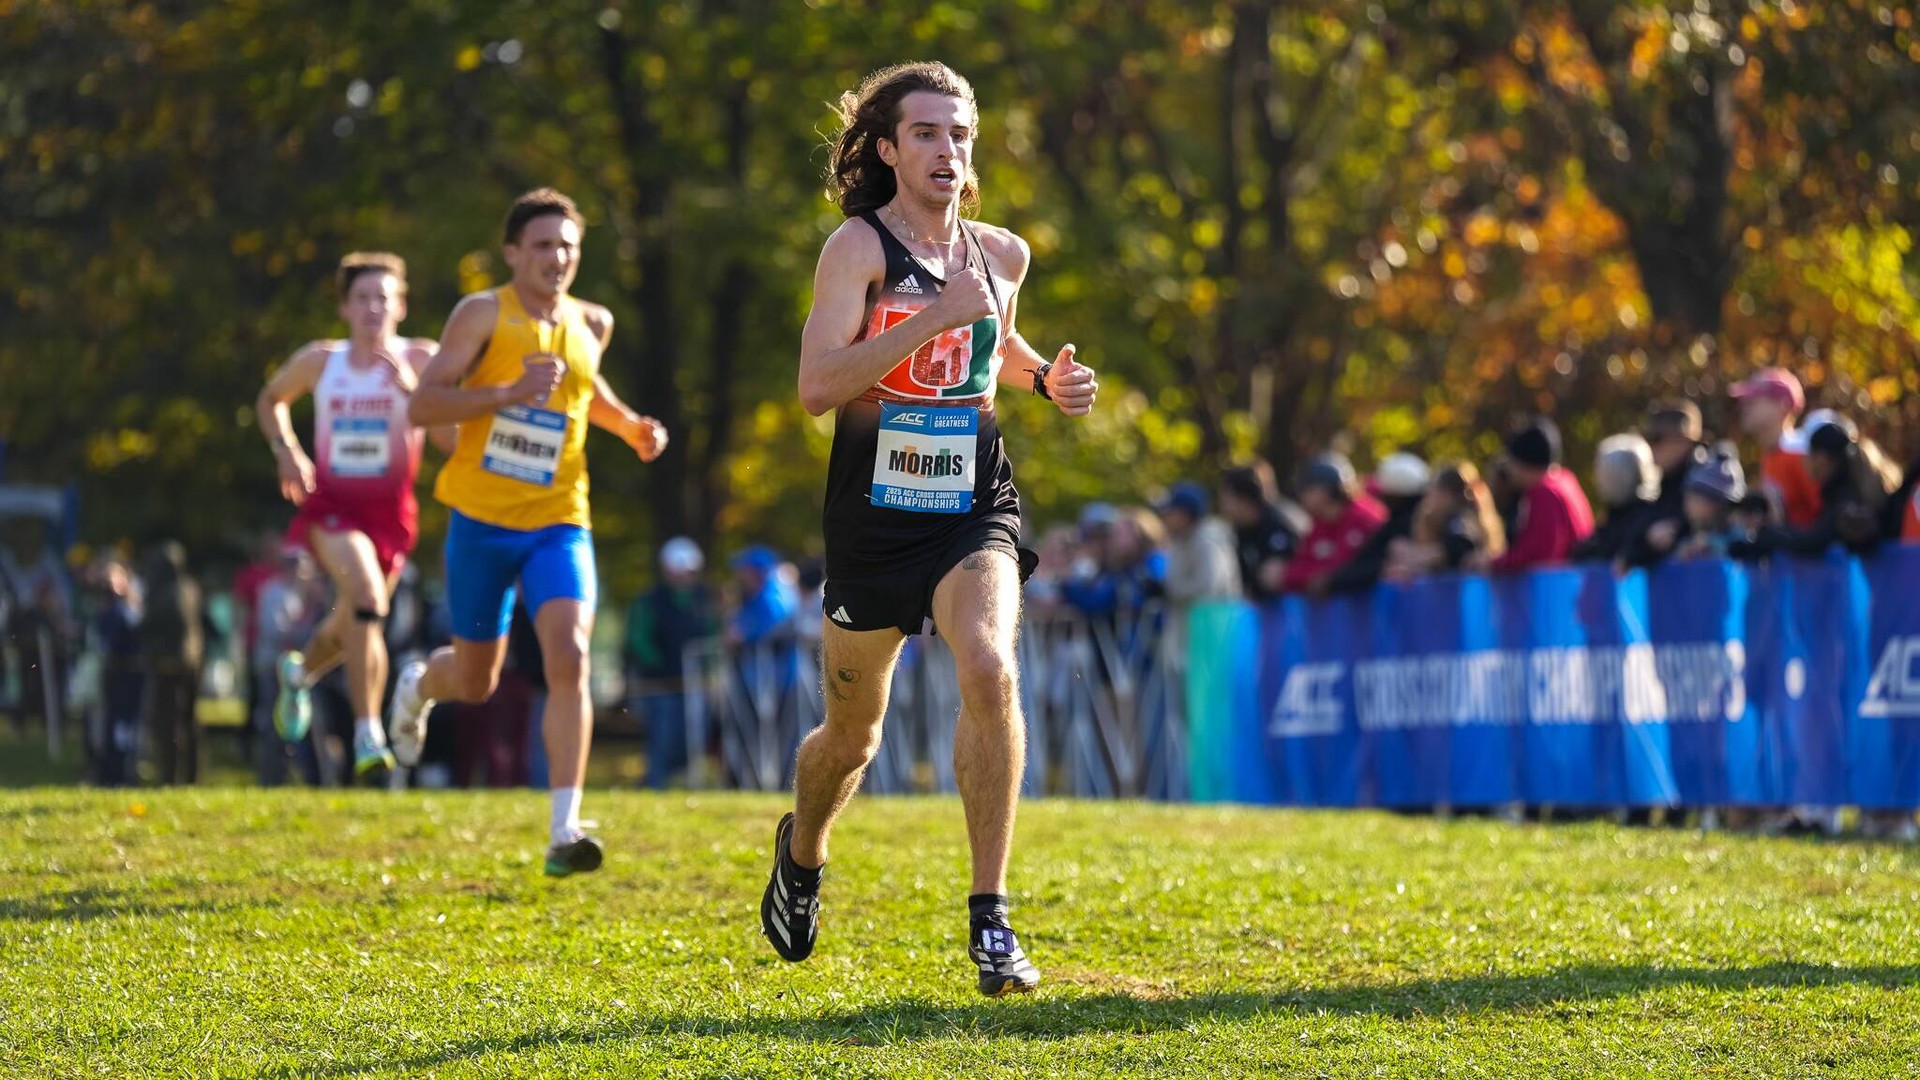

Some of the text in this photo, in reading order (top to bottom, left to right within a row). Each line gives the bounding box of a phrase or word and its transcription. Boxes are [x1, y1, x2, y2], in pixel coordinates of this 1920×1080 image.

[895, 285, 923, 295] adidas
[888, 412, 927, 426] ACC
[934, 419, 969, 428] GREATNESS
[888, 449, 963, 477] MORRIS
[886, 486, 960, 500] 2025 ACC CROSS COUNTRY
[884, 493, 960, 509] CHAMPIONSHIPS
[1269, 661, 1347, 737] ACC
[1530, 637, 1746, 725] CHAMPIONSHIPS
